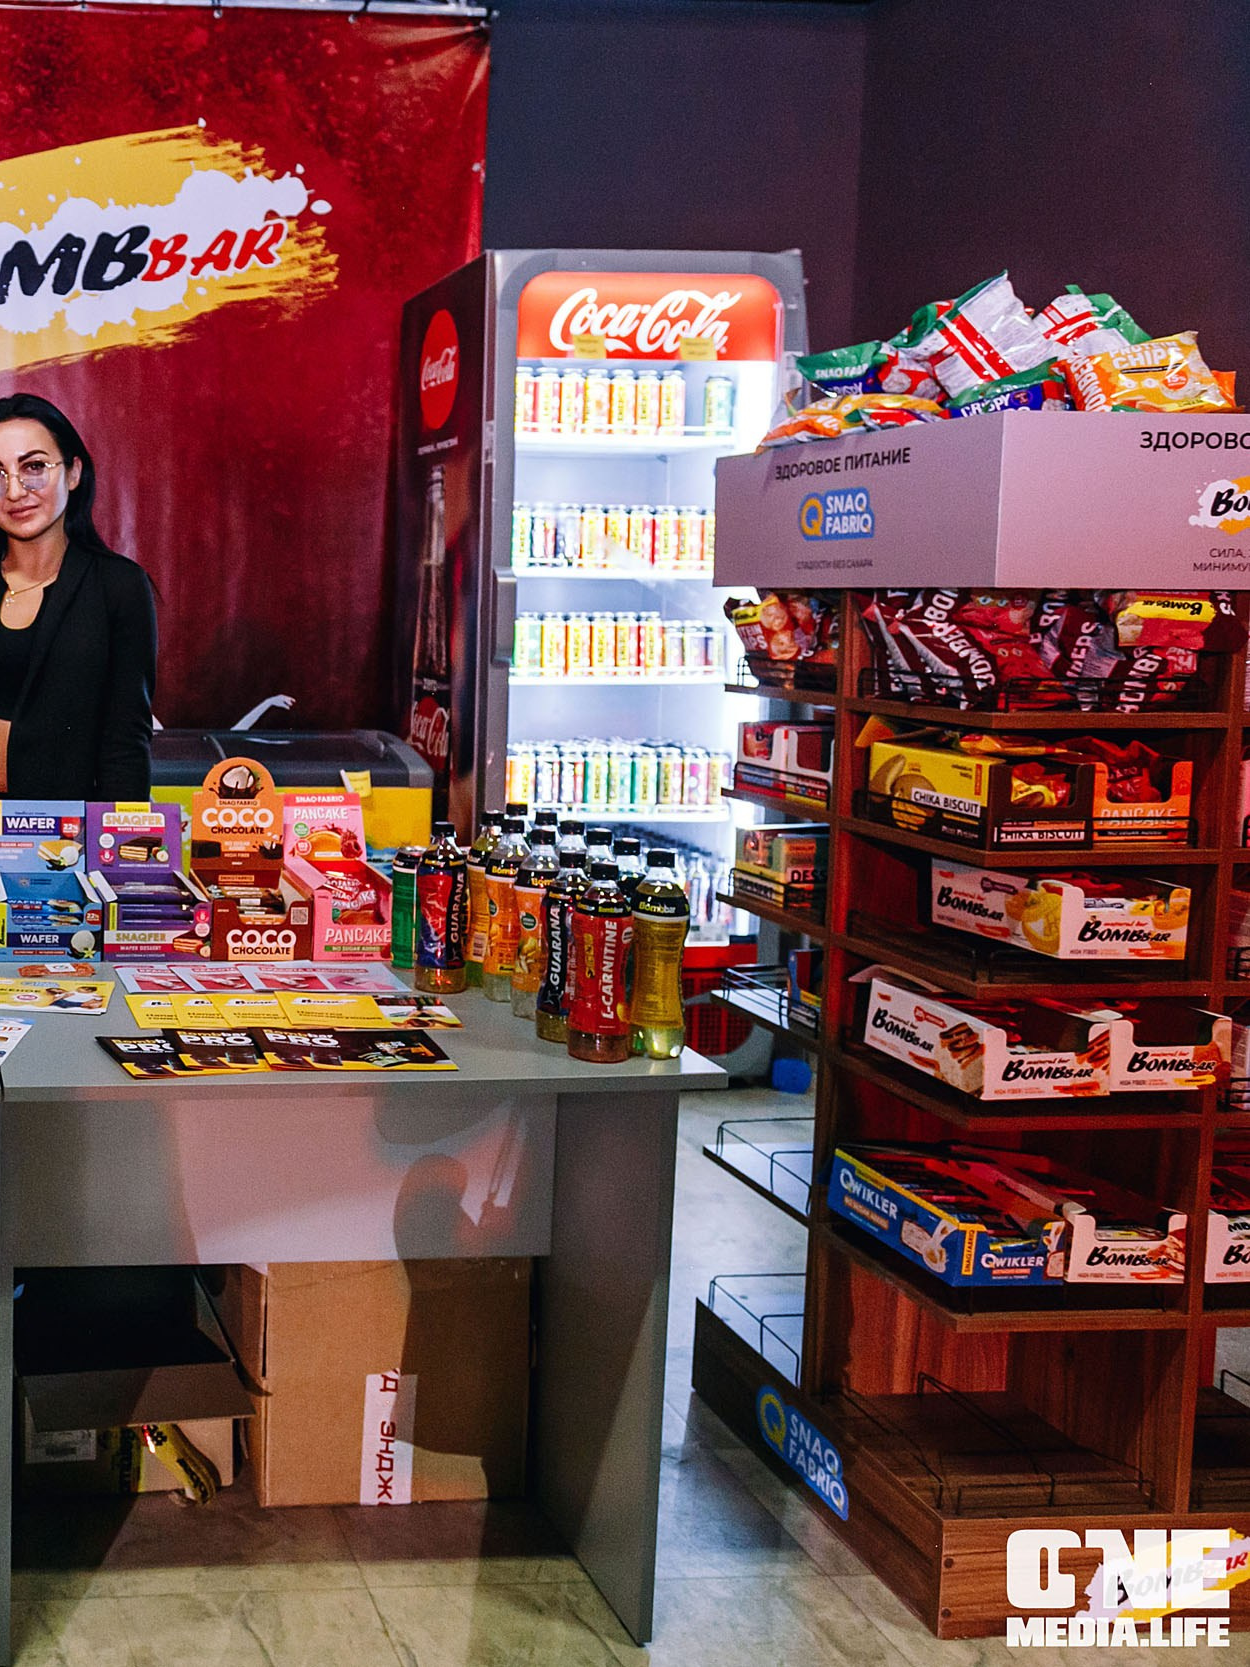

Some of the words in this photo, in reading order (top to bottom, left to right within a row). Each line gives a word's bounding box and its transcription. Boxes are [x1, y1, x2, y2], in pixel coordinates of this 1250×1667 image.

[550, 287, 742, 353] Coca-Cola
[775, 456, 841, 481] ЗДОРОВОЕ
[844, 447, 911, 471] ПИТАНИЕ
[826, 492, 867, 514] SNAQ
[825, 513, 872, 535] FABRIQ
[293, 807, 349, 820] PANCAKE
[913, 790, 941, 806] CHIKA
[944, 797, 980, 816] BISCUIT
[6, 817, 56, 829] WAFER
[104, 814, 163, 826] SNAQFER
[202, 807, 275, 828] COCO
[1099, 808, 1178, 825] PANCAKE
[211, 826, 265, 835] CHOCOLATE
[492, 866, 517, 875] Bomb
[791, 869, 827, 883] DESS
[451, 872, 465, 943] GUARANA
[639, 901, 676, 914] Bombbar
[937, 885, 1004, 921] BOMBBAR
[20, 934, 60, 944] WAFER
[115, 932, 166, 942] SNAQFER
[226, 929, 297, 948] COCO
[325, 928, 392, 943] PANCAKE
[1078, 920, 1171, 942] BOMBBAR
[232, 946, 291, 955] CHOCOLATE
[550, 903, 561, 985] GUARANA
[602, 920, 617, 1020] L-CARNITINE
[265, 1034, 341, 1047] PRO
[872, 1007, 934, 1053] BOMBBAR
[181, 1035, 253, 1047] PRO
[1002, 1059, 1094, 1082] BOMBBAR
[1127, 1051, 1215, 1072] BOMBBAR
[840, 1168, 898, 1220] QWIKLER
[981, 1252, 1044, 1269] QWIKLER
[1086, 1246, 1171, 1266] BOMBBAR
[790, 1413, 842, 1476] SNAQ
[375, 1420, 396, 1506] ЭНДЖ
[788, 1438, 847, 1510] FABRIQ
